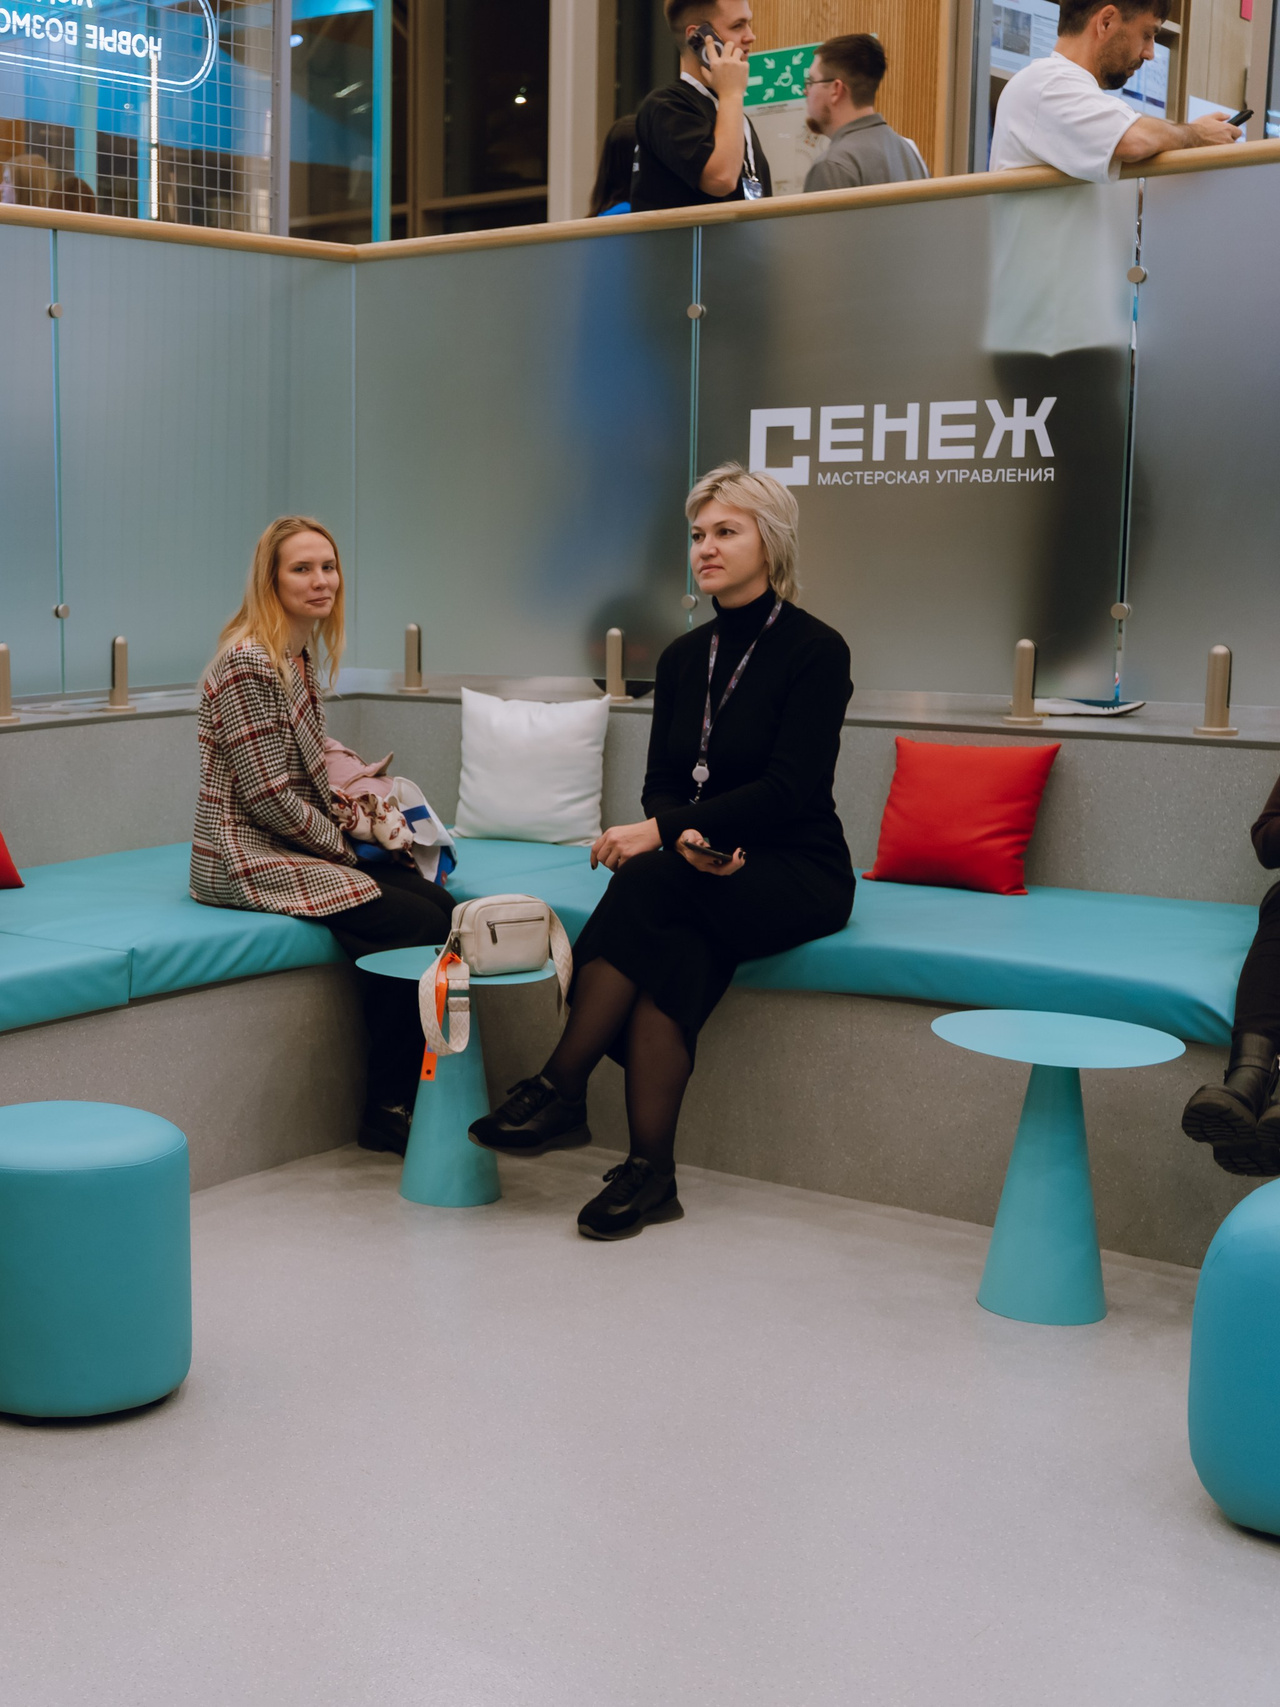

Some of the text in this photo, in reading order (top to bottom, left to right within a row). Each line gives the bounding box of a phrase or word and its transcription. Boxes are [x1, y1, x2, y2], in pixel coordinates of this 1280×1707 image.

[749, 397, 1057, 487] СЕНЕЖ
[817, 467, 1055, 486] МАСТЕРСКАЯ УПРАВЛЕНИЯ
